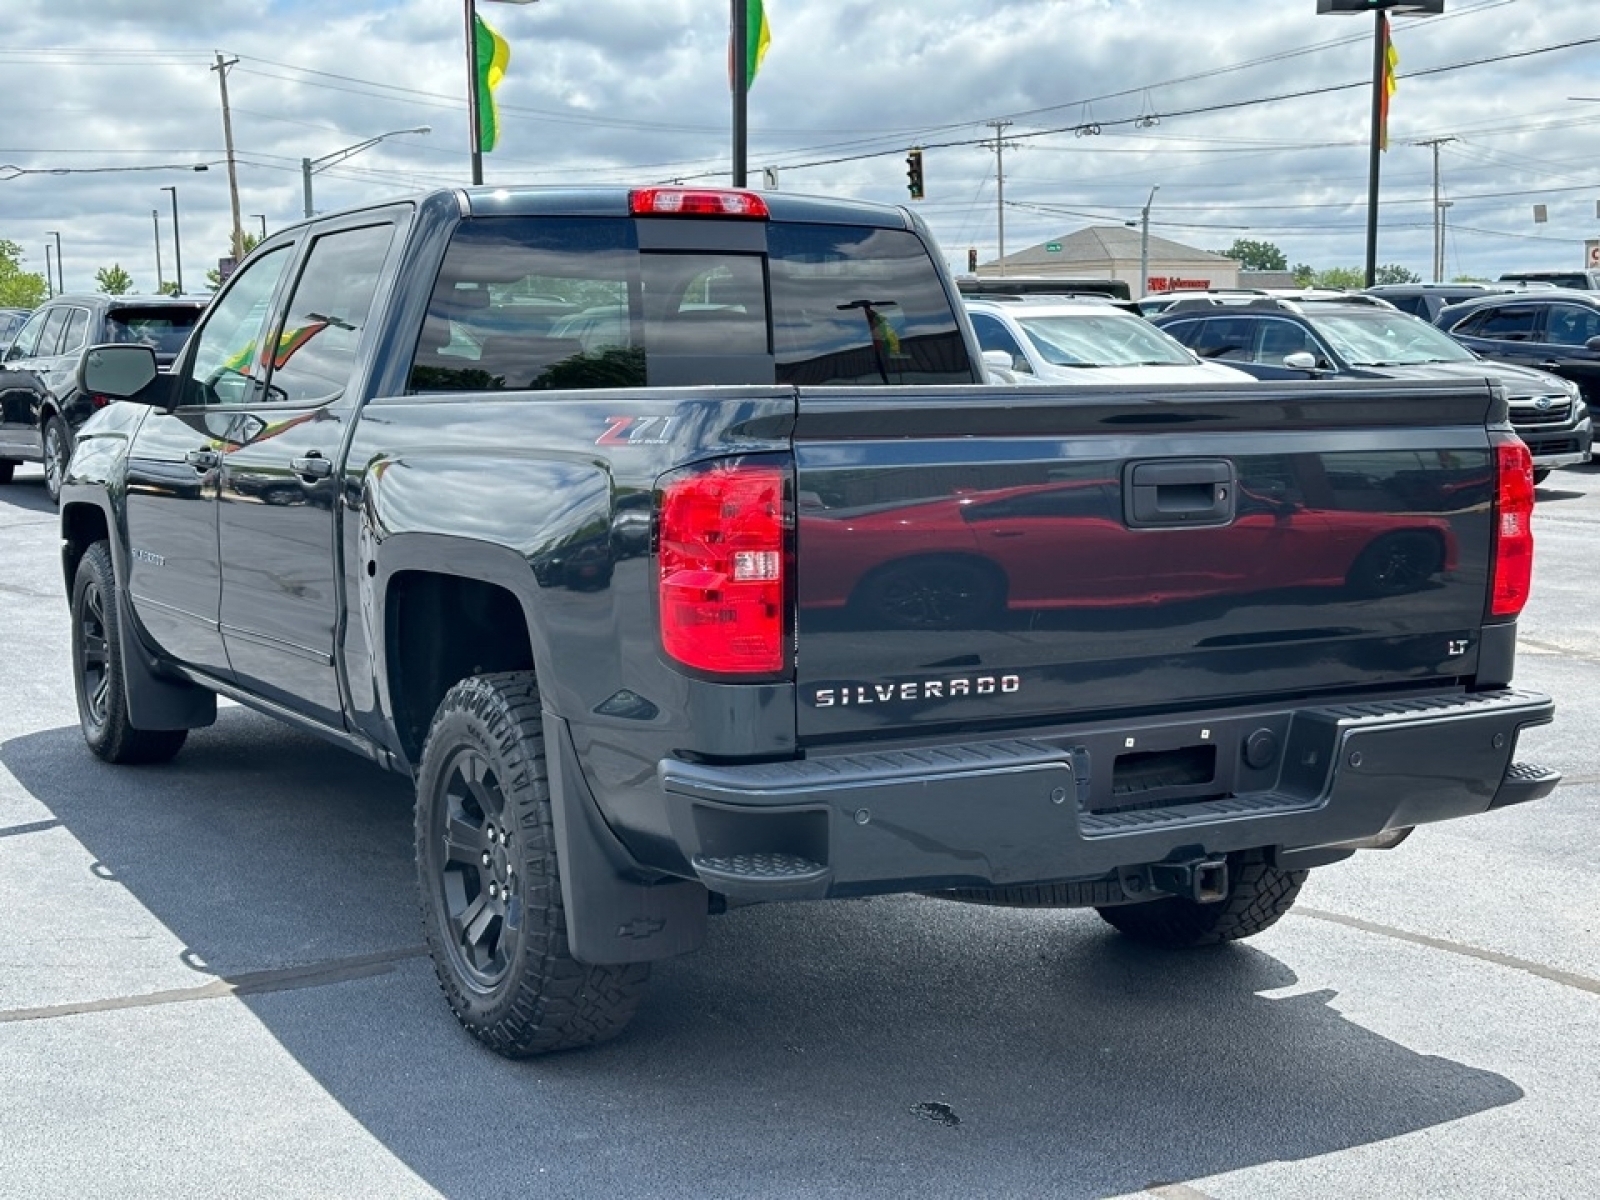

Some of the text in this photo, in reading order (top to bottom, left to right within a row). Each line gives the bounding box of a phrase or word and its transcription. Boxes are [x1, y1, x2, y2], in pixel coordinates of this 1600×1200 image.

[595, 415, 680, 446] Z71
[1448, 639, 1469, 656] LT
[815, 674, 1021, 708] SILVERADO
